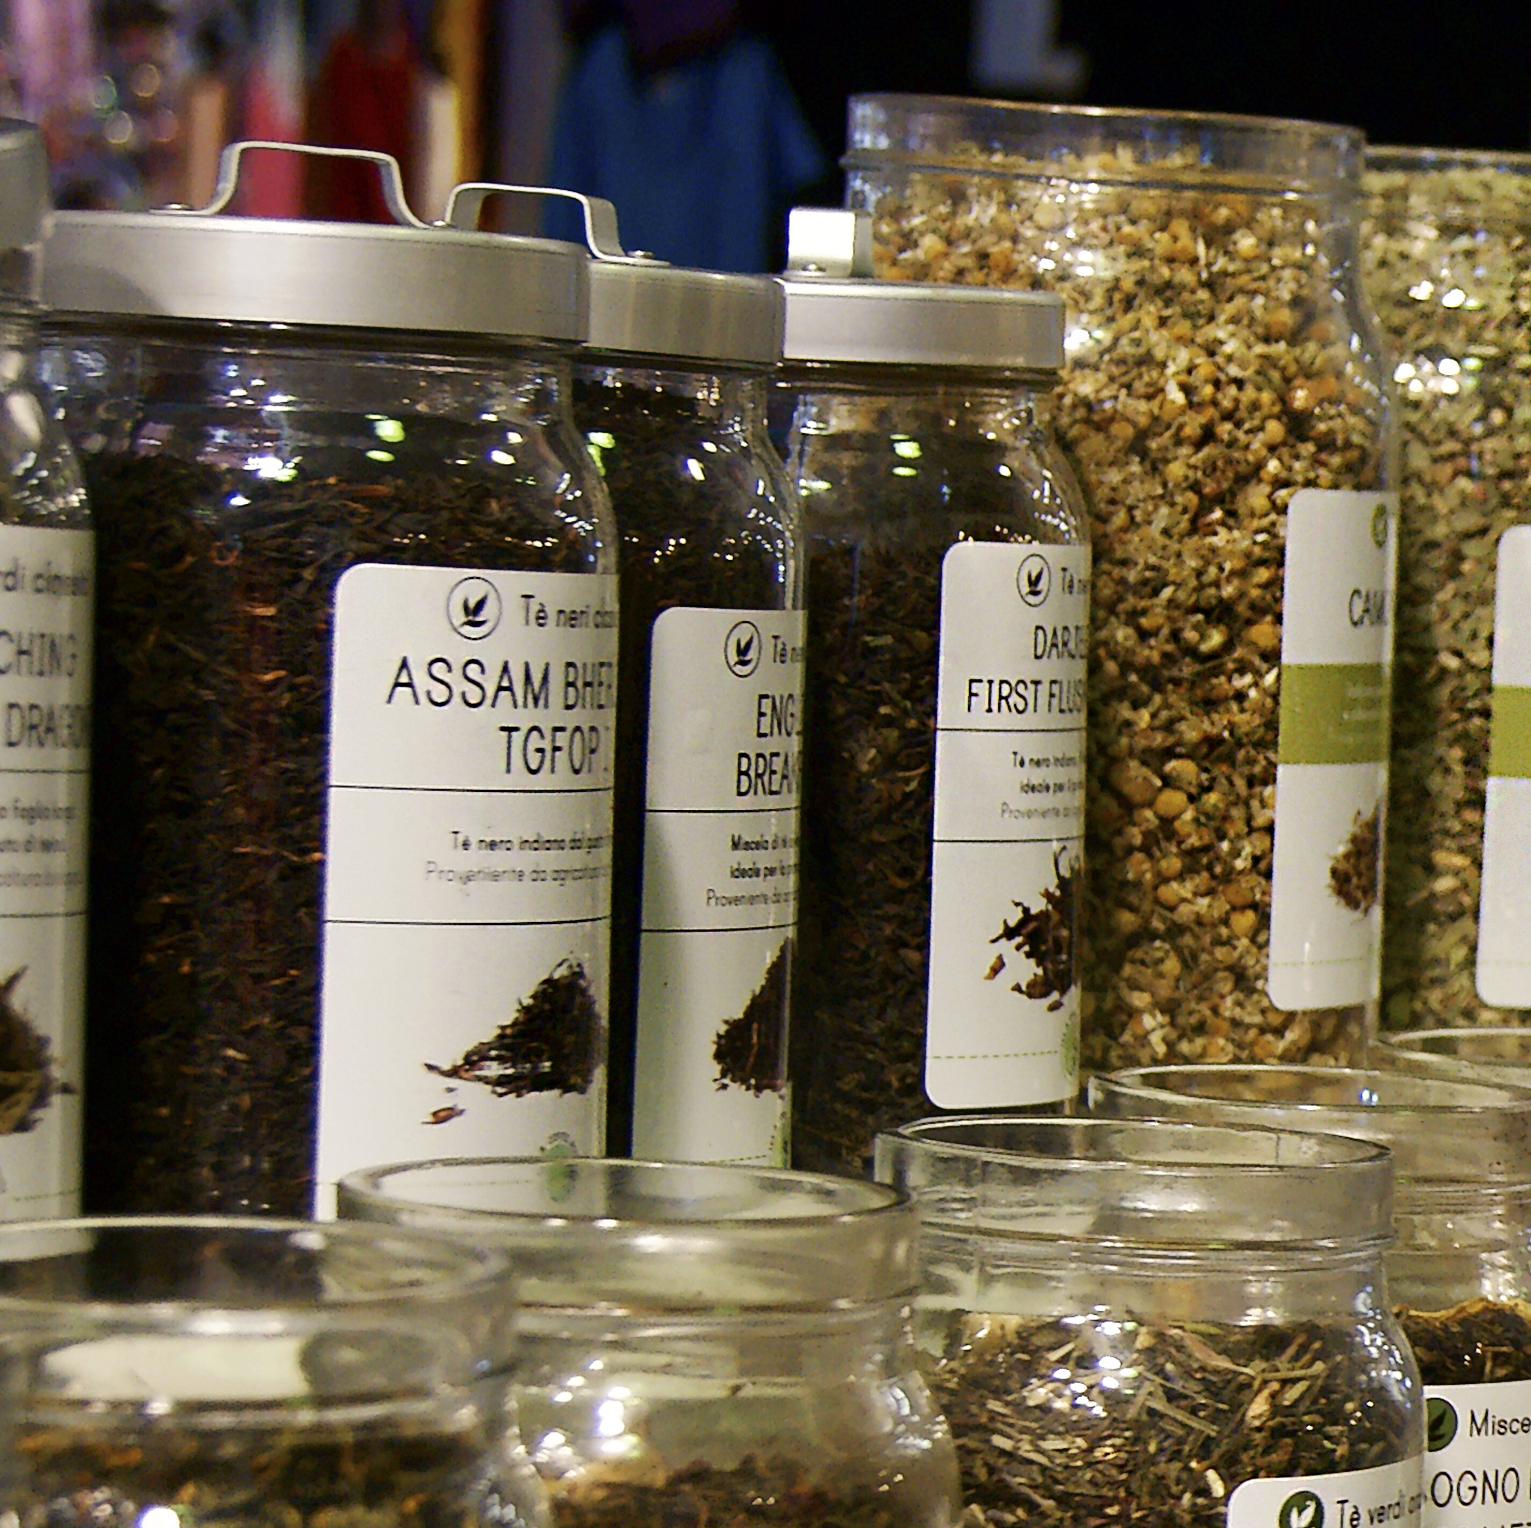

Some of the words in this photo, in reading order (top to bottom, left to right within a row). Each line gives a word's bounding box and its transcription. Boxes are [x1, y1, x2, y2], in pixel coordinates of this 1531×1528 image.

[521, 594, 549, 628] Tè
[386, 655, 550, 710] ASSAM
[967, 679, 1042, 714] FIRST
[757, 694, 803, 738] ENG
[451, 831, 471, 851] Tè
[478, 839, 514, 851] nero
[1430, 1467, 1520, 1508] OGNO
[1336, 1499, 1361, 1528] Tè
